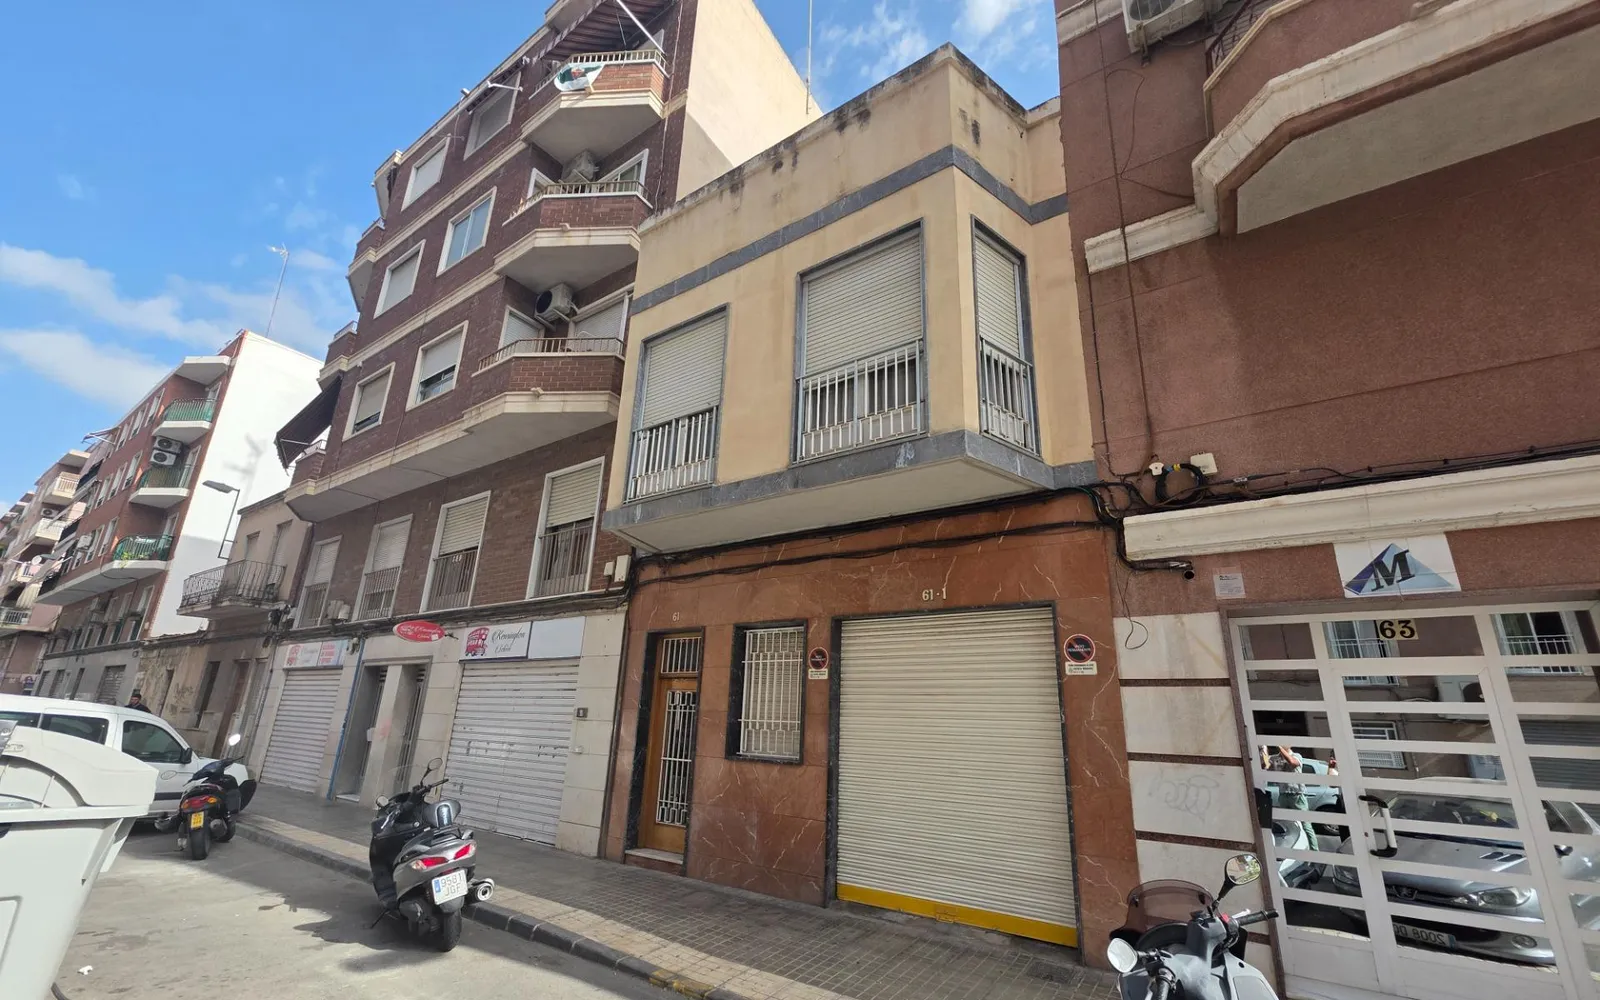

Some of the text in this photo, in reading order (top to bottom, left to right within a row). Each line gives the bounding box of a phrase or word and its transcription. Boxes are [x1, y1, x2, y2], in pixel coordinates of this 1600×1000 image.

[1371, 549, 1415, 592] M
[672, 611, 680, 622] 61
[1379, 619, 1416, 639] 63
